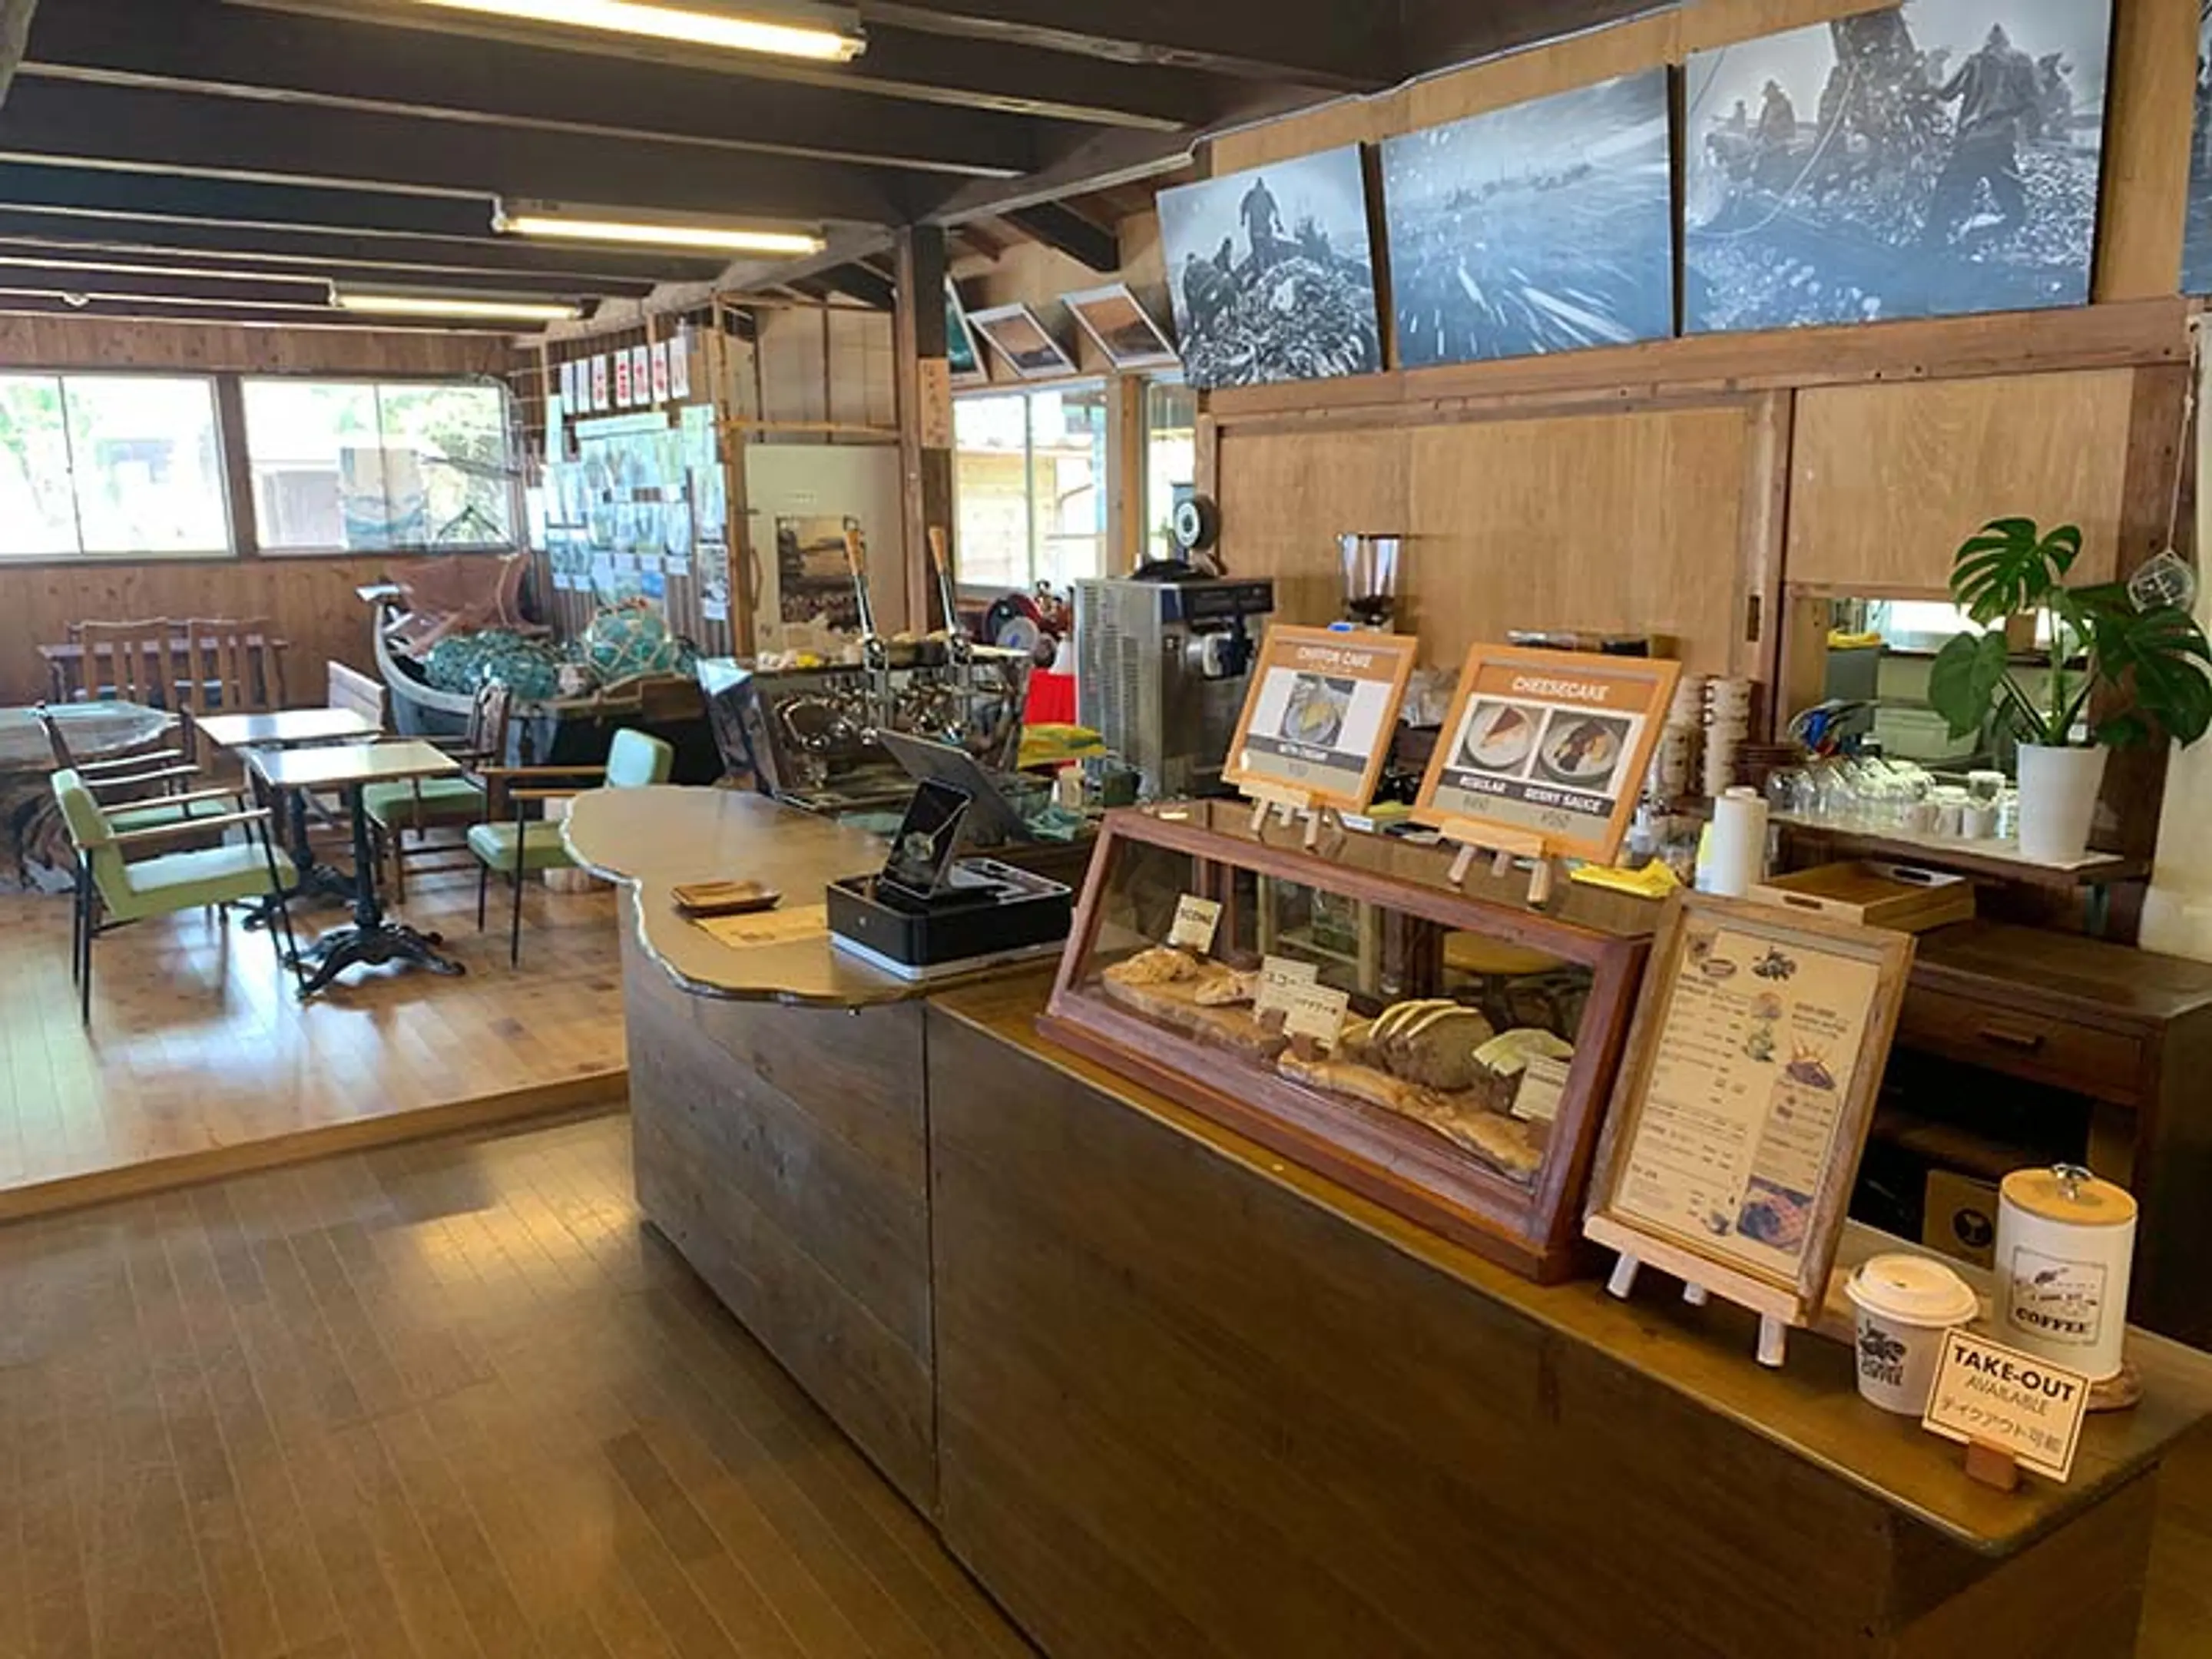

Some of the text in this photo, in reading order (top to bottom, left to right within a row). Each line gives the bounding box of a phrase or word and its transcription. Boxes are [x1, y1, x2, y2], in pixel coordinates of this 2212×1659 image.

[1512, 675, 1609, 702] CHEESECAKE
[1563, 792, 1603, 813] SAUCE
[2015, 1307, 2091, 1334] COFFEE
[1954, 1345, 2075, 1402] TAKE-OUT
[1965, 1375, 2049, 1417] AVAILABLE
[1939, 1394, 2063, 1454] テイクアウト可能
